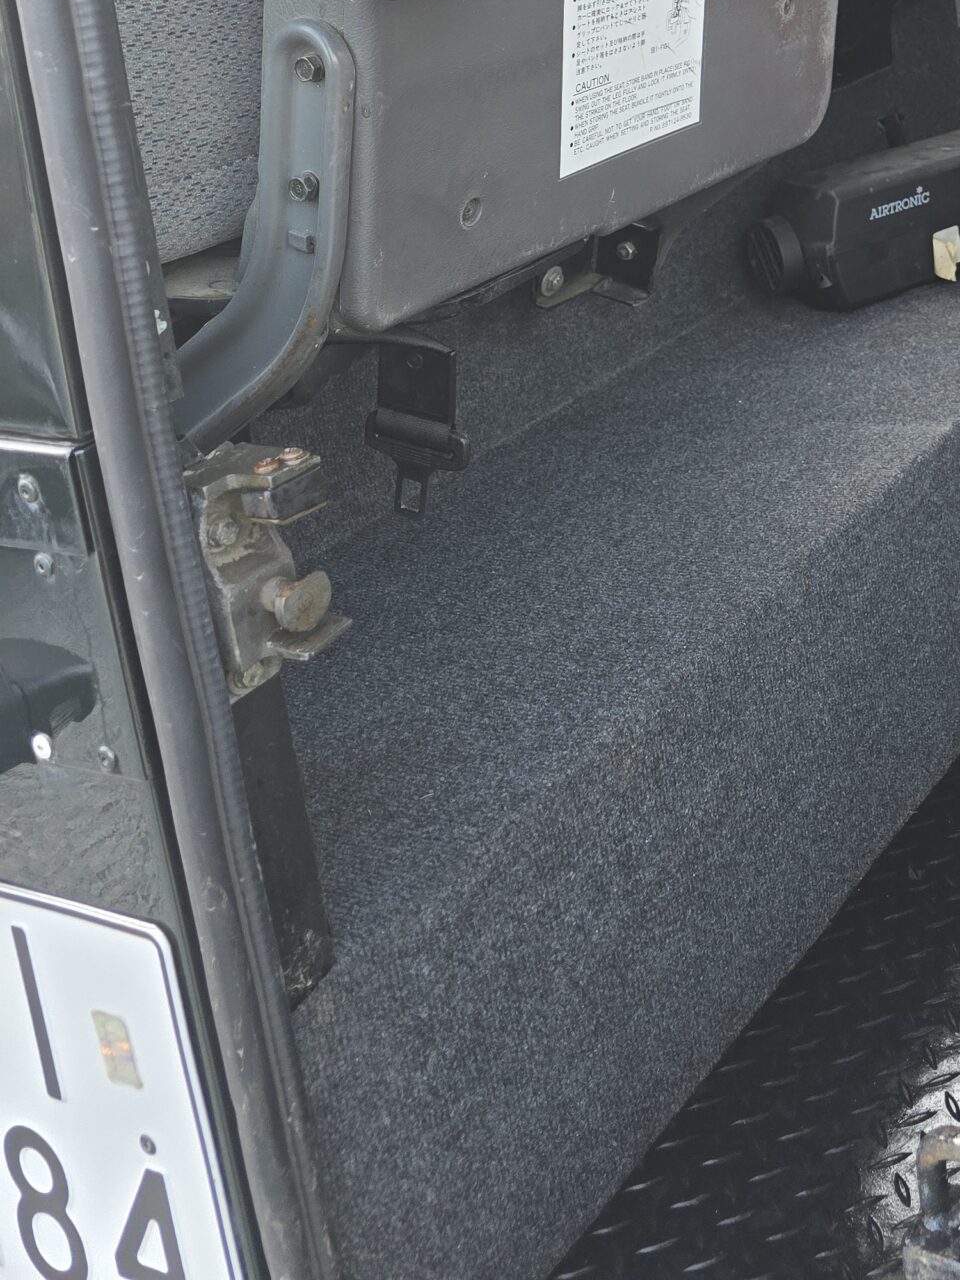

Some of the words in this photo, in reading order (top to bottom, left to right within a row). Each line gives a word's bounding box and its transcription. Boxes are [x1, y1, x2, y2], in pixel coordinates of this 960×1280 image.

[575, 95, 589, 105] WHEN
[590, 90, 603, 100] USING
[604, 87, 613, 95] THE
[626, 77, 640, 87] STORE
[659, 66, 673, 76] PLACE
[575, 103, 589, 113] SWING
[591, 99, 600, 107] OUT
[613, 92, 621, 100] LEG
[623, 86, 637, 96] FULLY
[638, 83, 646, 91] AND
[648, 79, 659, 87] LOCK
[576, 74, 610, 93] CAUTION
[575, 119, 588, 129] WHEN
[590, 112, 608, 124] STORING
[610, 108, 619, 117] THE
[631, 97, 649, 109] BUNDLE
[655, 89, 672, 100] TIGHTLY
[685, 81, 694, 89] THE
[575, 113, 584, 122] THE
[585, 106, 604, 118] STRIKER
[605, 103, 611, 111] ON
[613, 100, 621, 108] THE
[574, 128, 587, 138] HAND
[574, 139, 581, 147] BE
[582, 130, 603, 143] CAREFUL
[605, 126, 614, 135] NOT
[616, 123, 622, 131] TO
[623, 119, 632, 128] GET
[586, 138, 604, 150] CAUGHT
[606, 132, 619, 142] WHEN
[620, 124, 639, 137] SETTING
[640, 121, 649, 129] AND
[650, 113, 669, 125] STORING
[869, 186, 930, 221] AIRTRONIC
